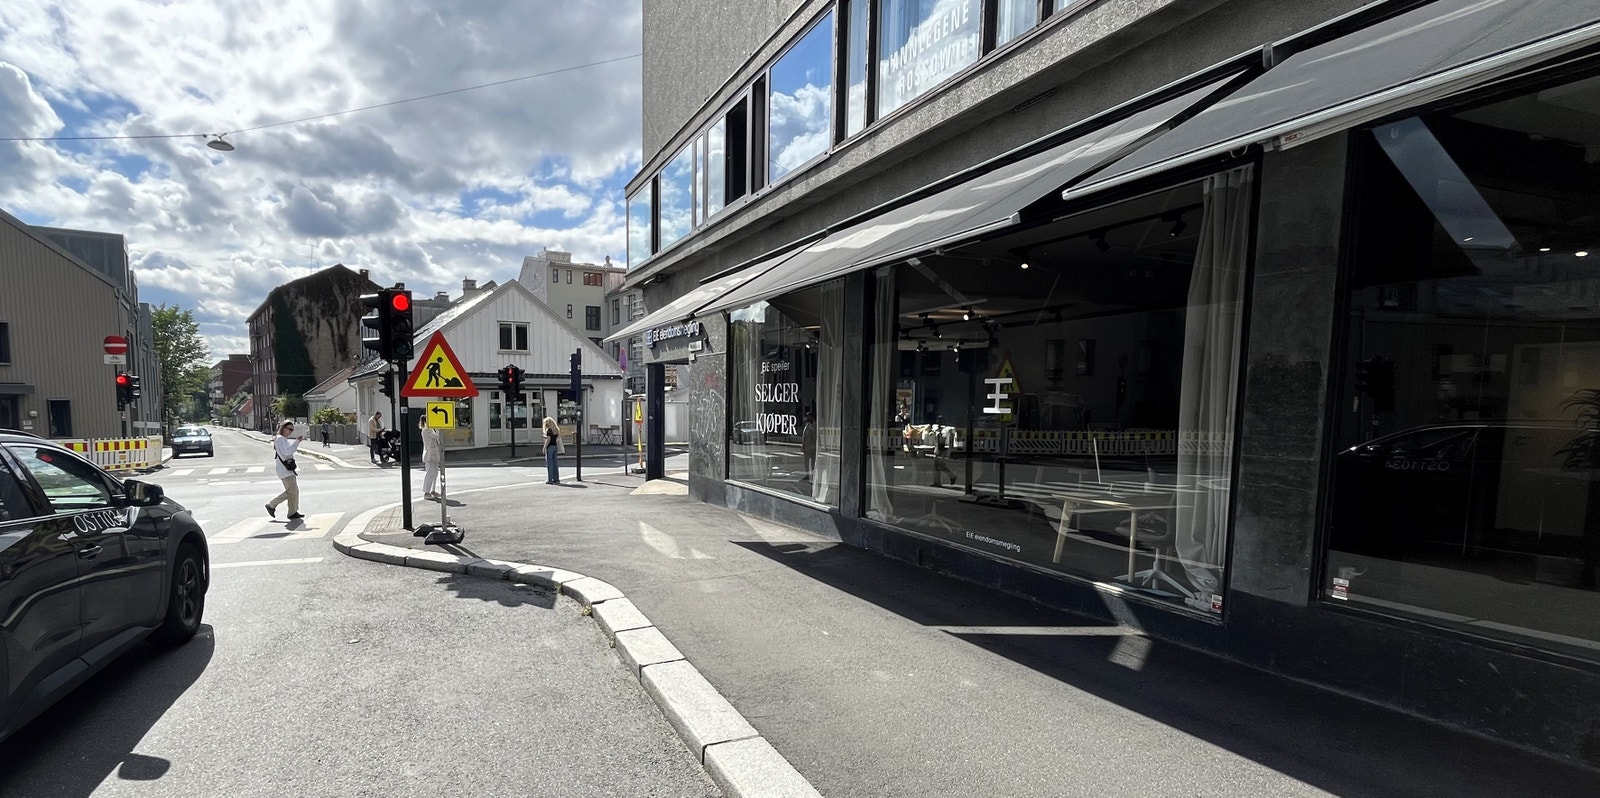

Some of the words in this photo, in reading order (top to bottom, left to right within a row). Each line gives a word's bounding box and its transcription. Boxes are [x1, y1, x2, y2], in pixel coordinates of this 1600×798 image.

[888, 0, 969, 73] ANNLEGENE
[755, 382, 799, 403] SELGER
[755, 412, 798, 435] KJØPER
